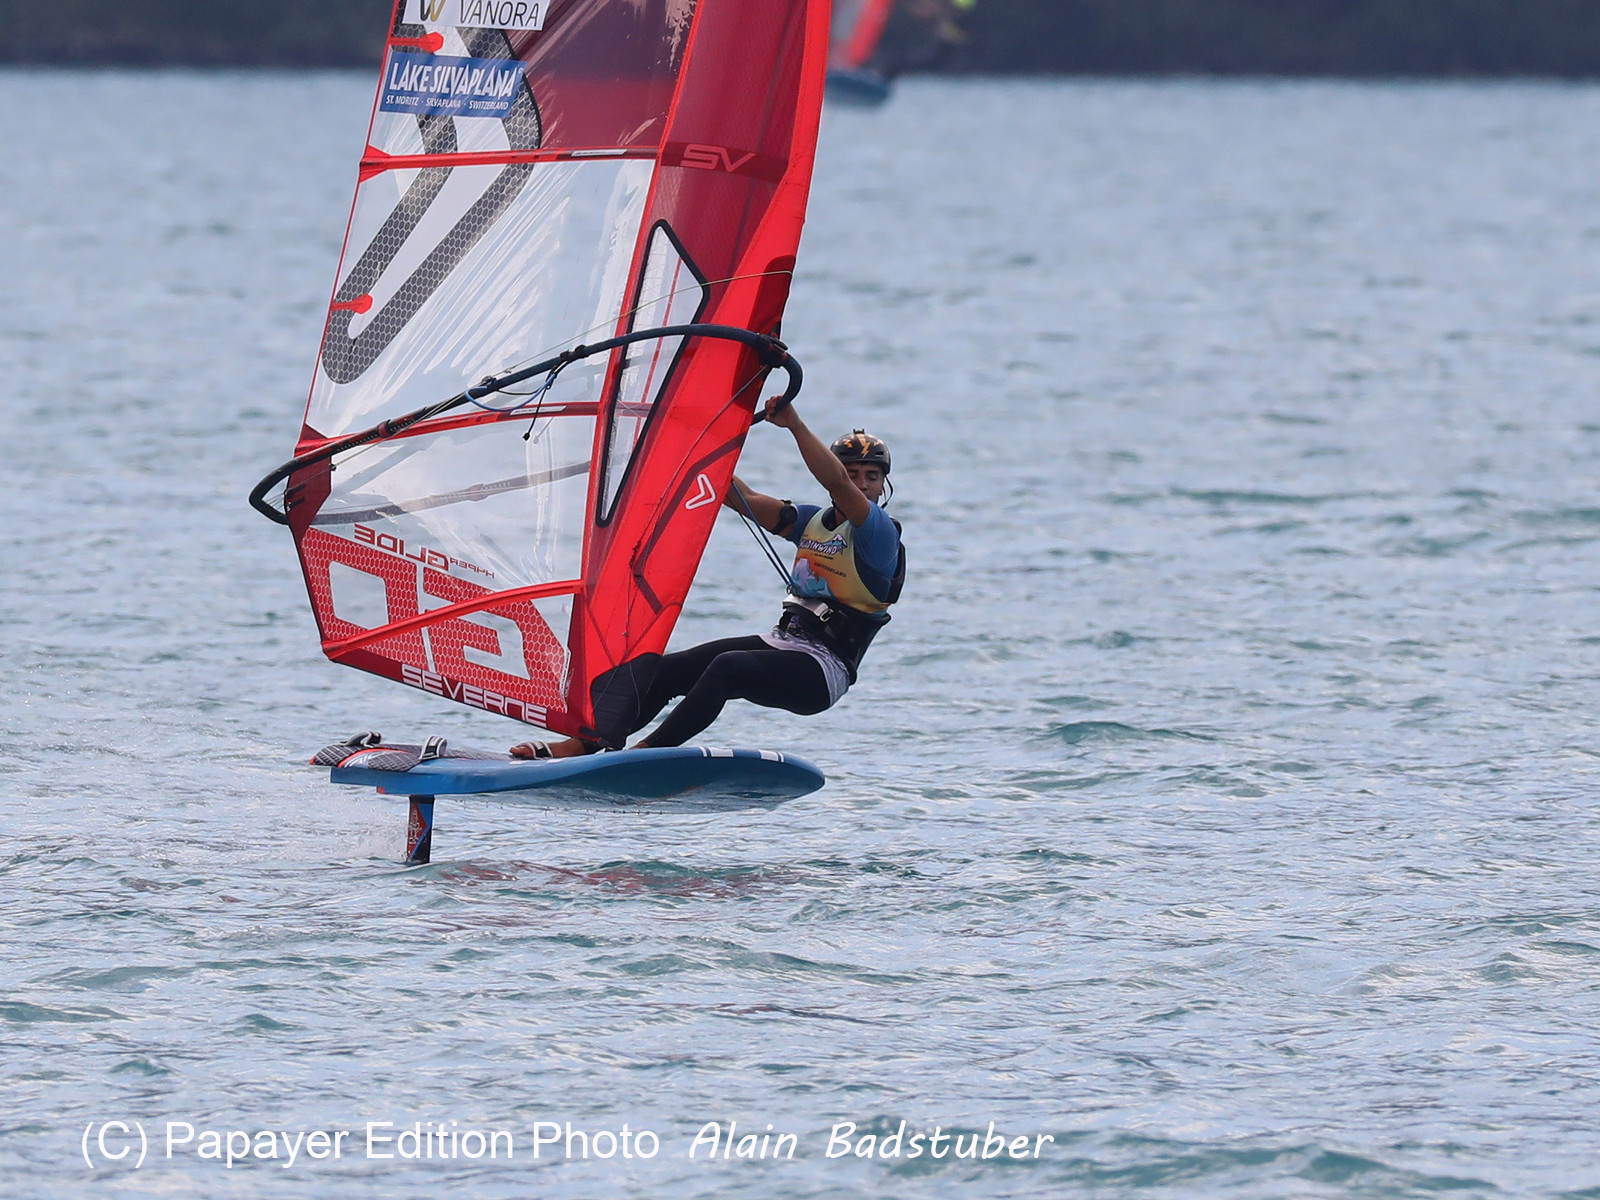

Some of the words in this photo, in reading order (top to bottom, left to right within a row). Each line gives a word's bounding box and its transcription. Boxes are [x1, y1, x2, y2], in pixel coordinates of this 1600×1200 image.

[389, 60, 432, 92] LAKE
[468, 99, 509, 110] SWITZERLAND
[401, 663, 548, 728] SEVERNE
